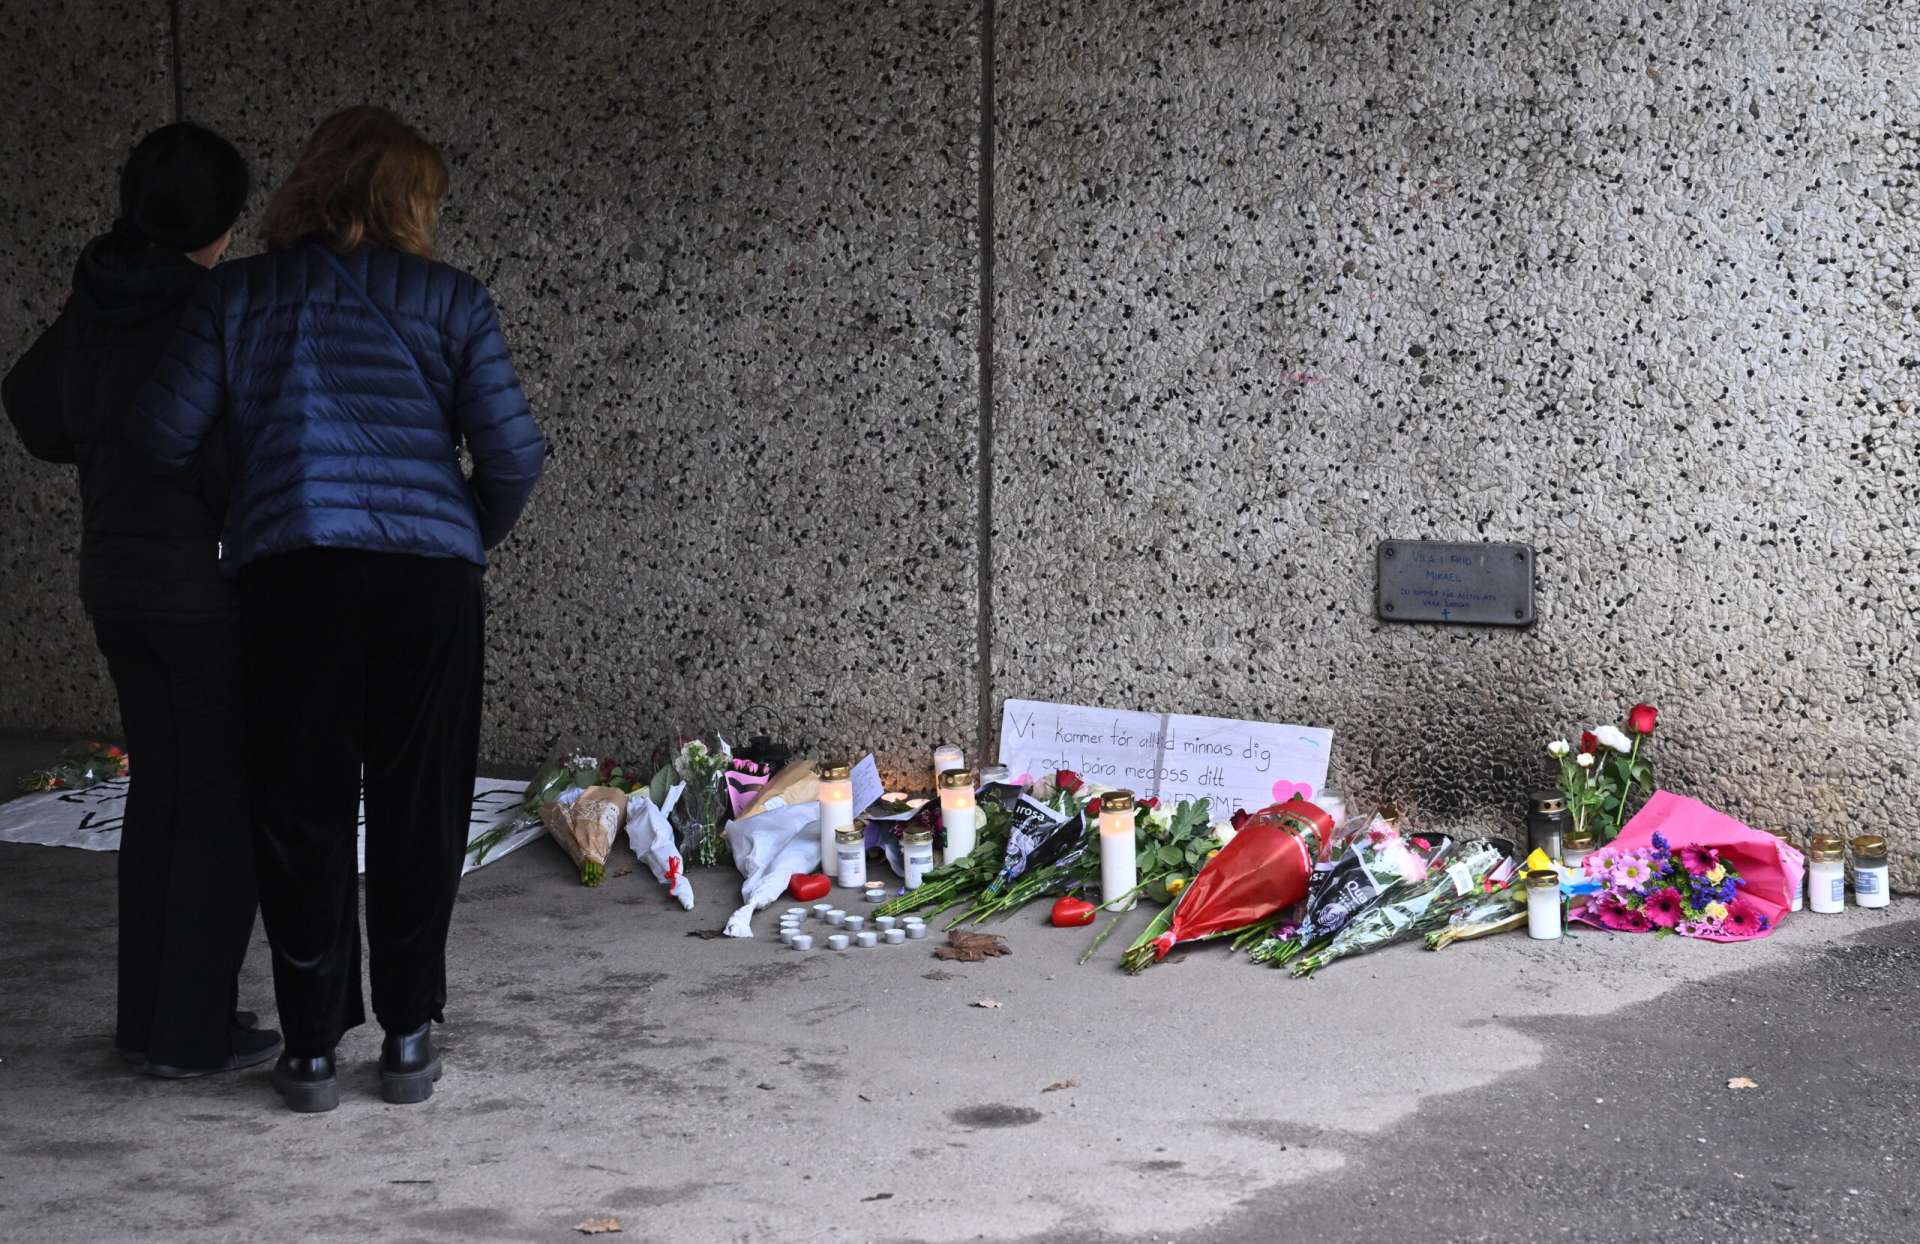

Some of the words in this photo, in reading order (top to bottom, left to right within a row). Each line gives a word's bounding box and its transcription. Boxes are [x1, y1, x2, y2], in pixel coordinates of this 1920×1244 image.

[1009, 711, 1035, 740] Vi
[1054, 713, 1103, 744] kommer
[1110, 718, 1133, 747] för
[1138, 728, 1175, 751] alltid
[1183, 737, 1233, 756] minnas
[1242, 735, 1271, 772] dig
[1041, 751, 1070, 771] och
[1081, 753, 1116, 777] bära
[1125, 759, 1155, 780] med
[1158, 767, 1189, 783] oss
[1198, 766, 1225, 787] ditt
